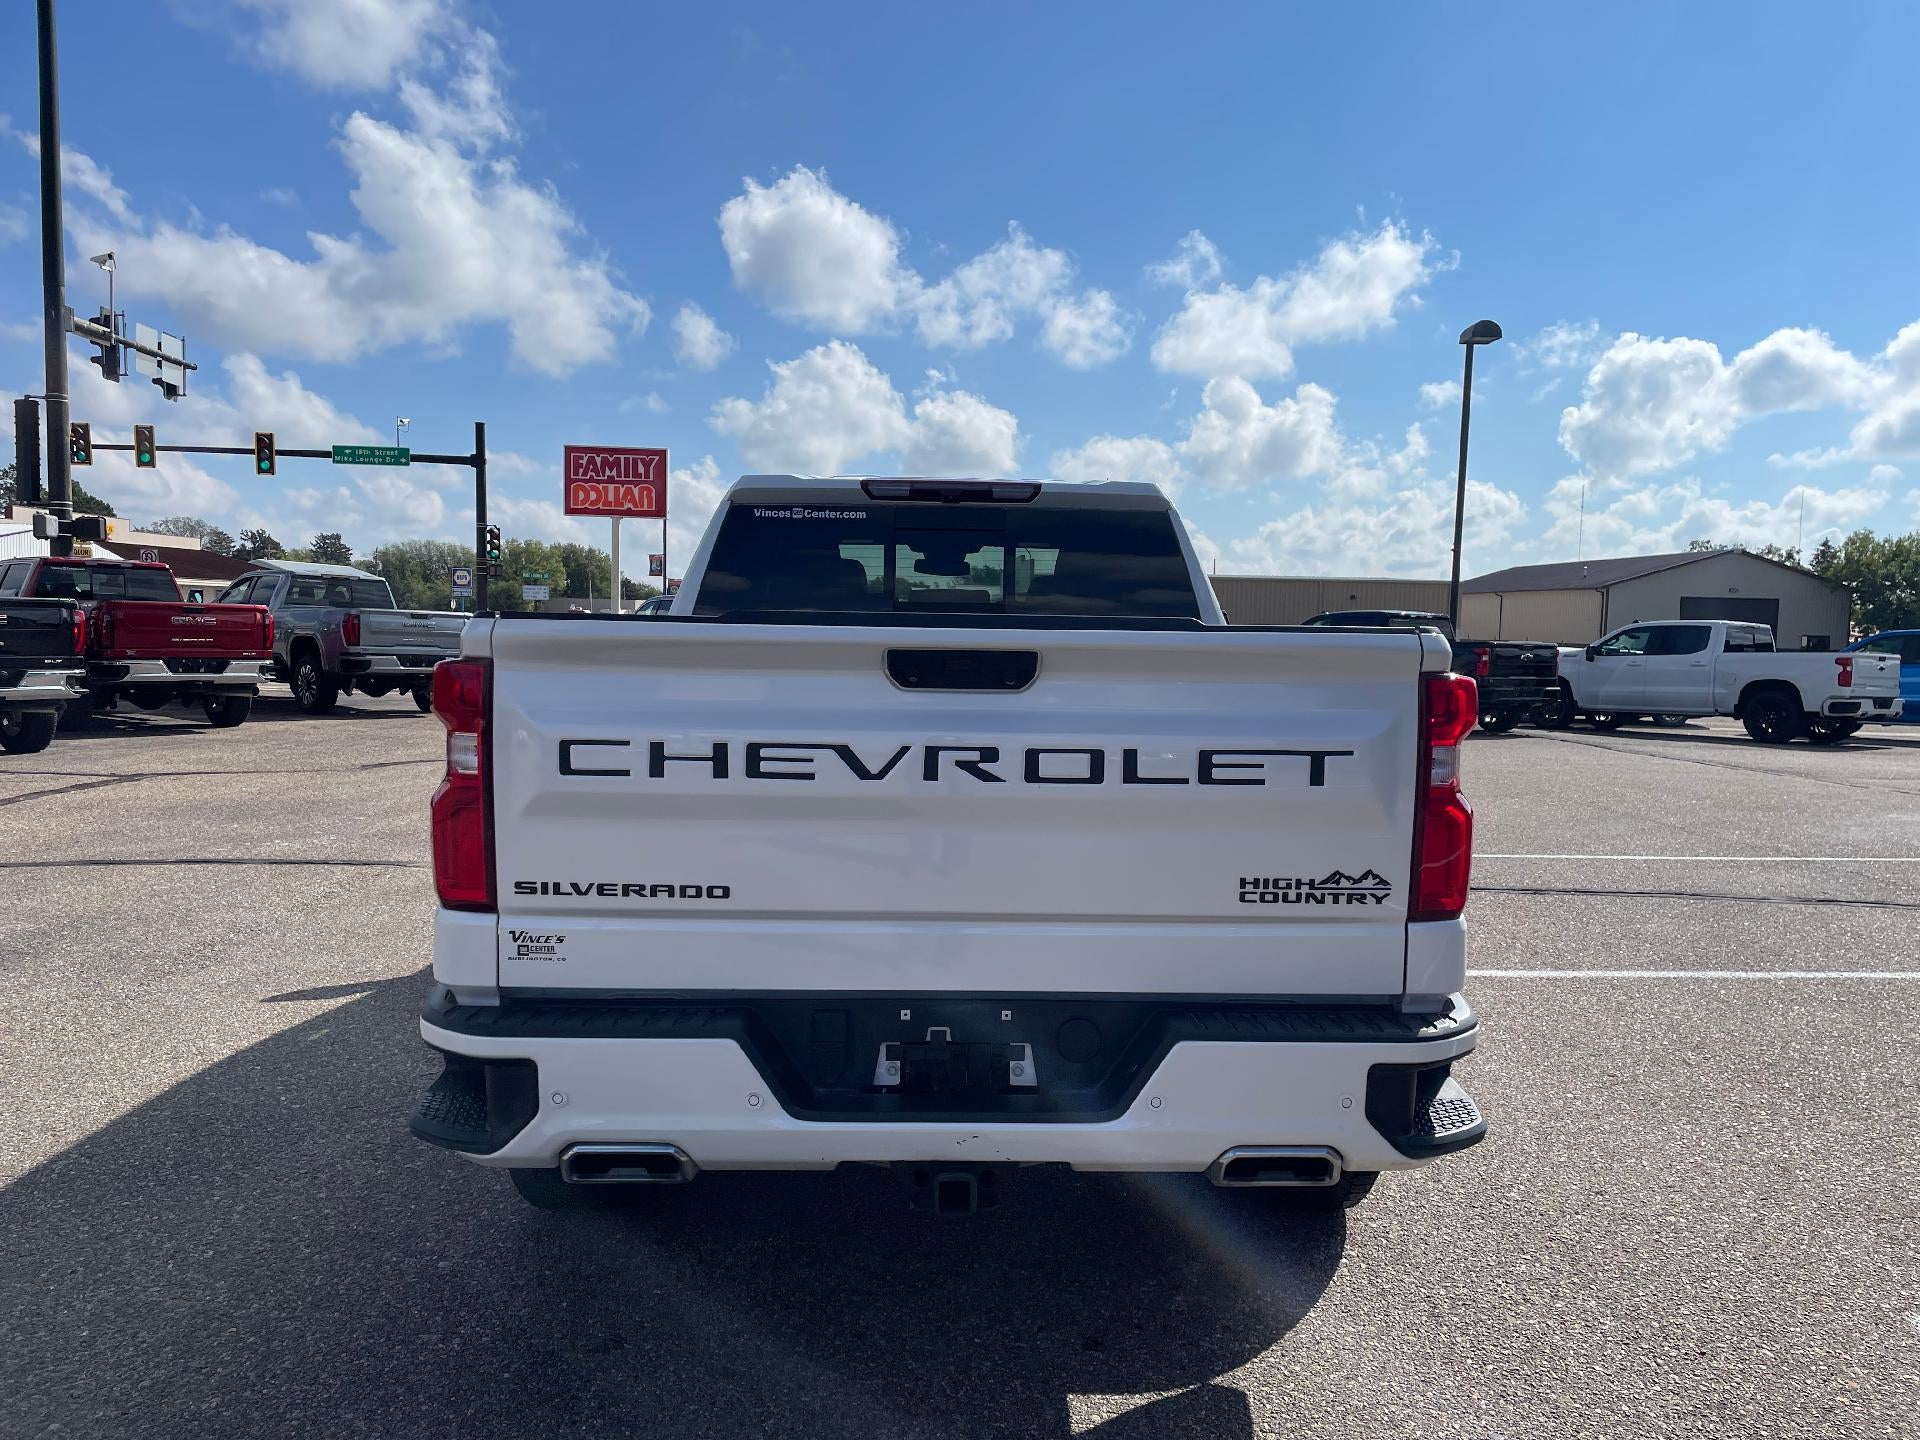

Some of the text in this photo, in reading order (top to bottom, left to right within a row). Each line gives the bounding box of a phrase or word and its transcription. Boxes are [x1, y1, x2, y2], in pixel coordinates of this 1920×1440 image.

[355, 456, 383, 464] Lounge
[571, 453, 659, 480] FAMILY
[571, 482, 656, 510] DOLLAR
[753, 508, 791, 518] Vinces
[171, 616, 217, 625] GMC
[559, 739, 1355, 787] CHEVROLET
[514, 881, 731, 899] SILVERADO
[1240, 877, 1316, 890] HIGH
[1239, 891, 1391, 904] COUNTRY
